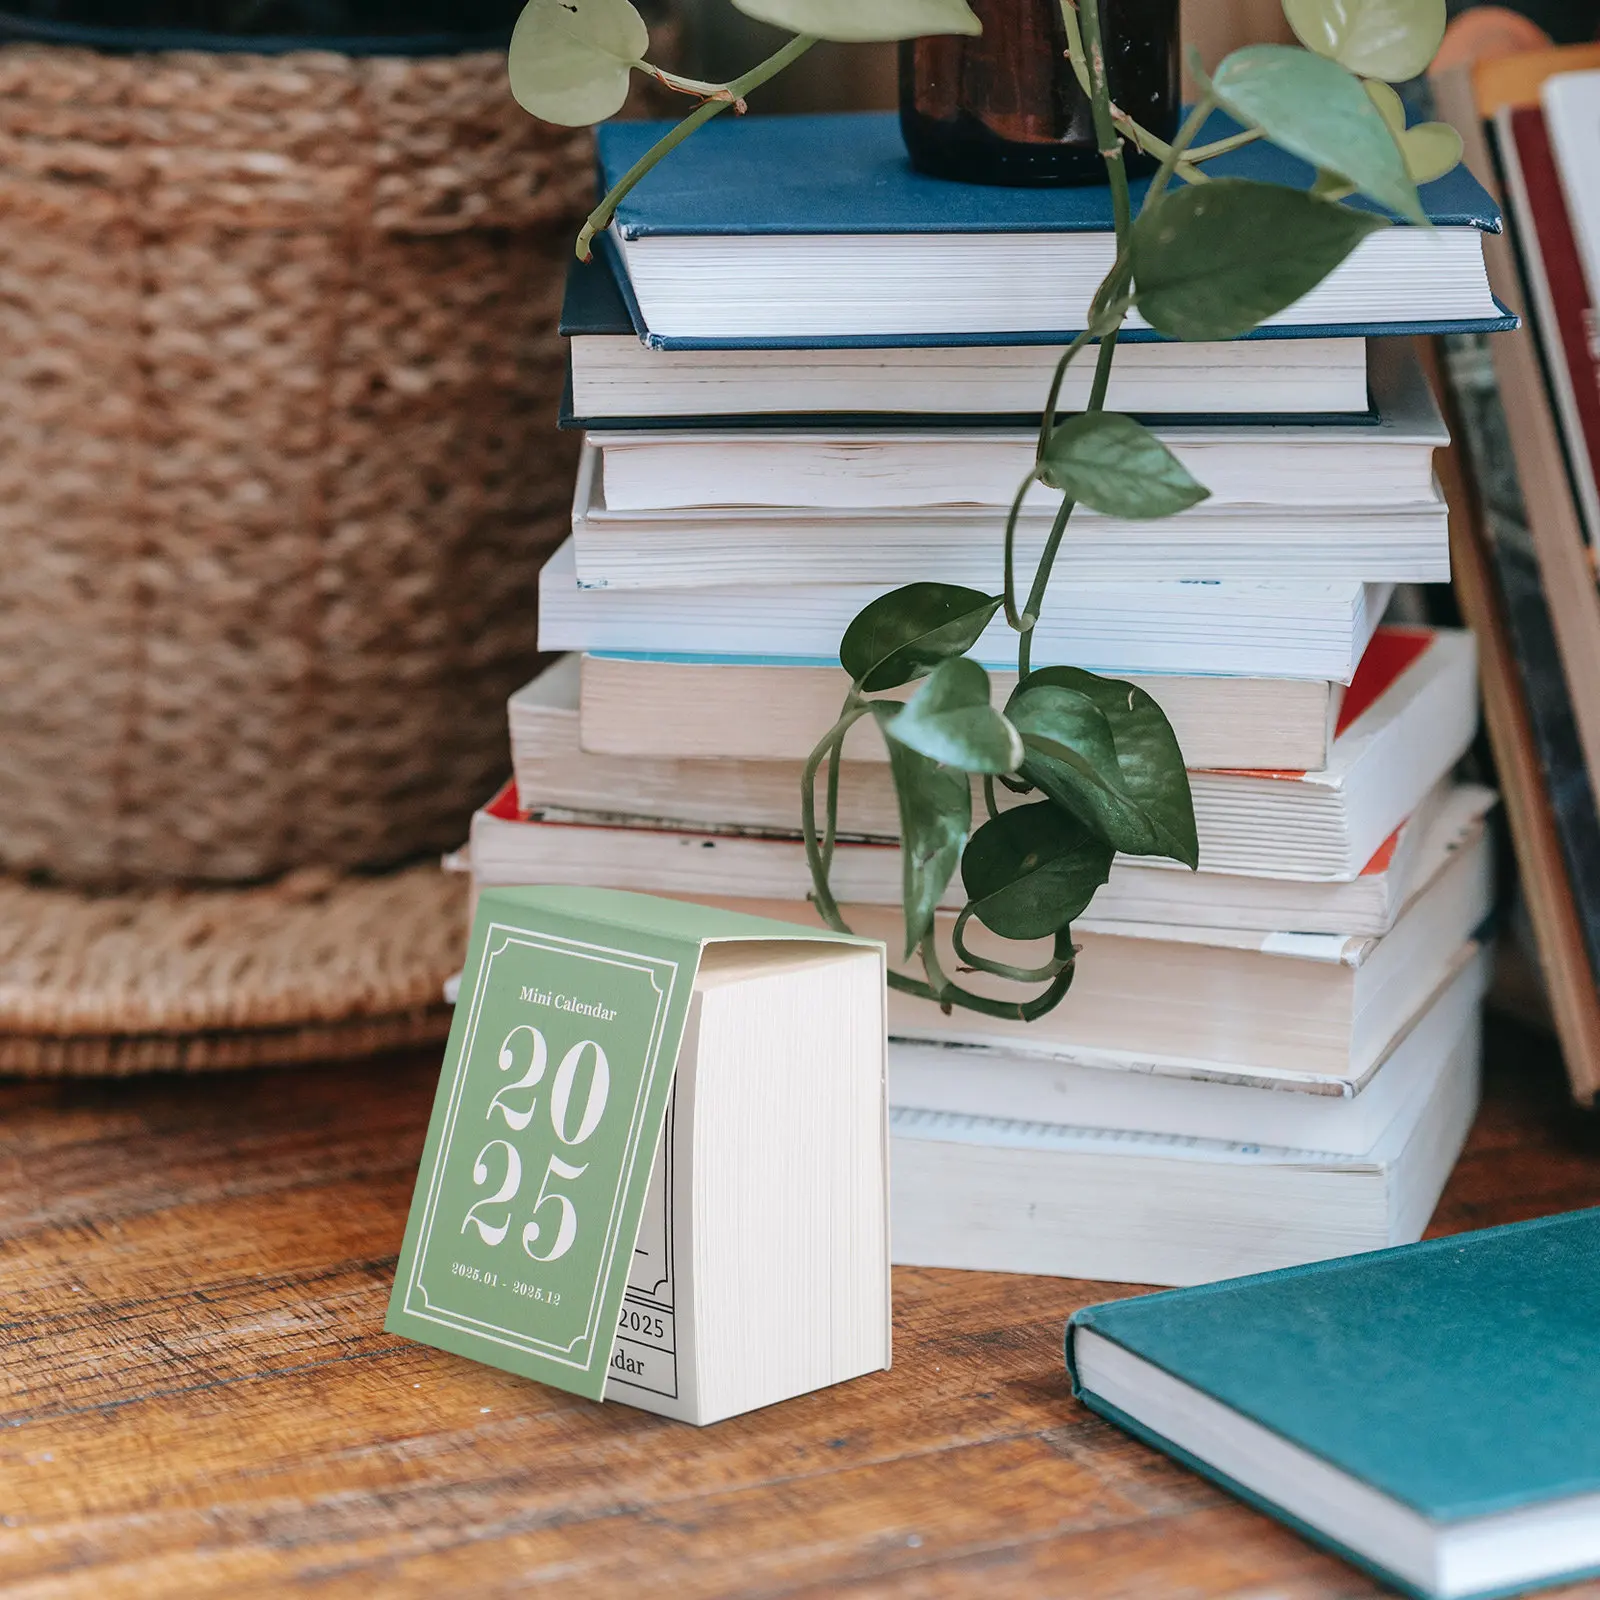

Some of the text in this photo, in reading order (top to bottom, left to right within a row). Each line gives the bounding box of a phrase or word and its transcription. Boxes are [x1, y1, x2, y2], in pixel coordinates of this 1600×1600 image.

[519, 985, 617, 1021] Mini Calendar
[485, 1024, 611, 1146] 20
[460, 1139, 590, 1263] 25
[451, 1261, 498, 1288] 2025.01
[512, 1280, 561, 1306] 2025.12
[618, 1307, 664, 1339] 2025
